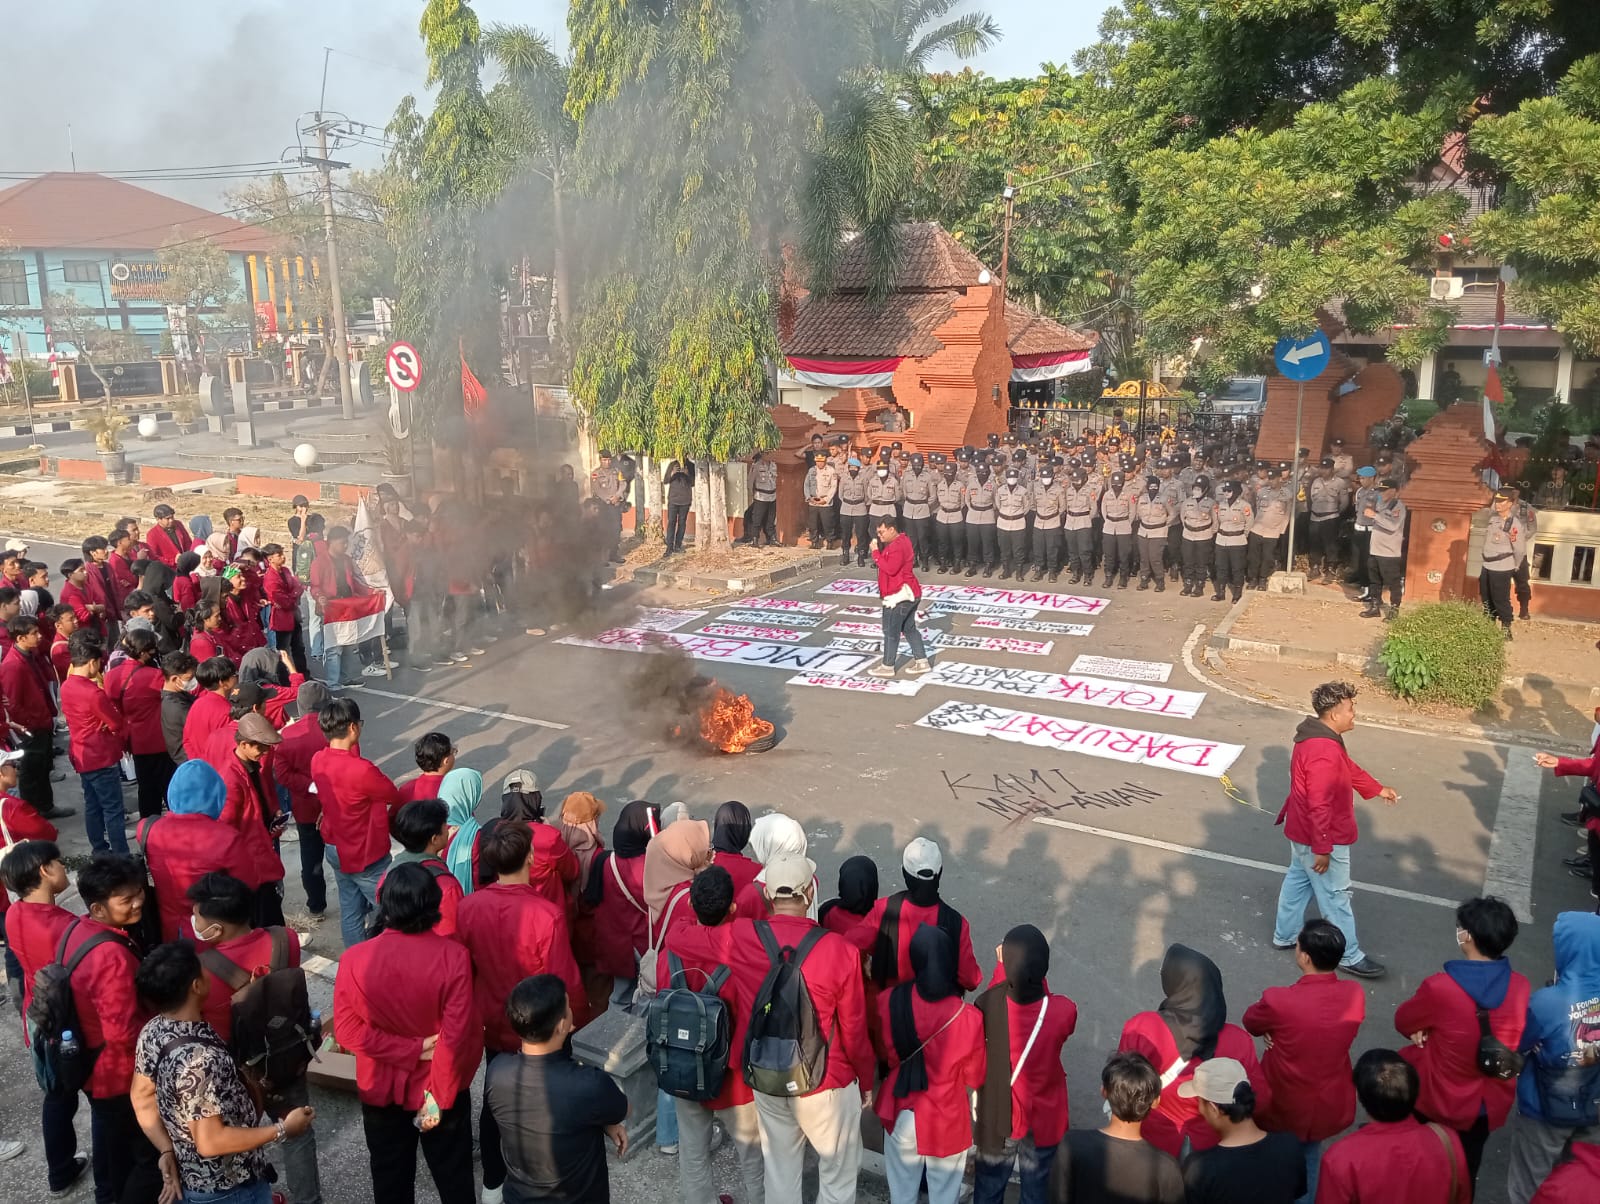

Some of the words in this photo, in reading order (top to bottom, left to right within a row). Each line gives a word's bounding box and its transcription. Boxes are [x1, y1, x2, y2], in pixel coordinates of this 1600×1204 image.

[131, 264, 174, 273] ATR/BP
[993, 590, 1104, 612] KAWAL
[743, 645, 868, 671] UMC
[931, 672, 1038, 694] POLITIK
[1048, 677, 1186, 716] TOLAK
[984, 714, 1218, 767] DARURAT
[941, 768, 1086, 800] KAMI
[976, 782, 1163, 821] MELAWAN
[1576, 997, 1600, 1011] FOUND
